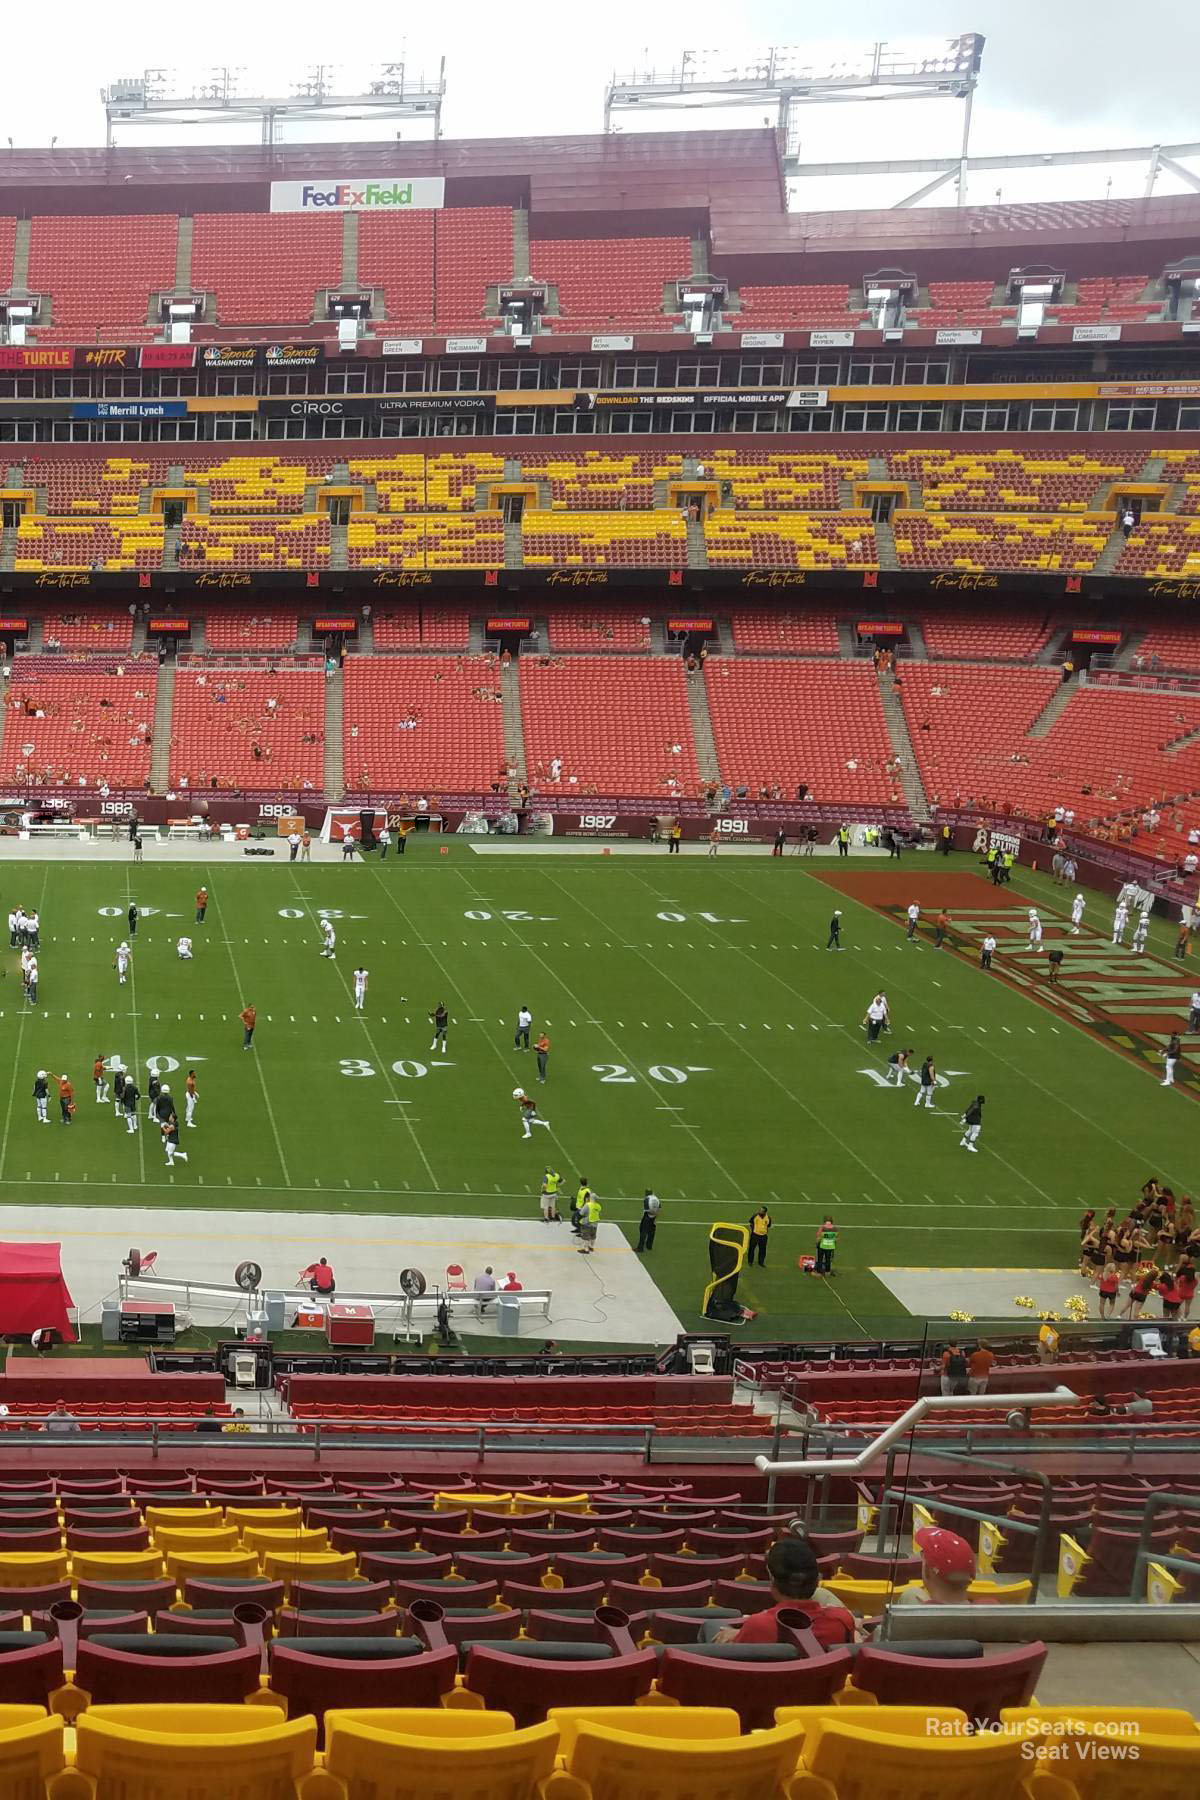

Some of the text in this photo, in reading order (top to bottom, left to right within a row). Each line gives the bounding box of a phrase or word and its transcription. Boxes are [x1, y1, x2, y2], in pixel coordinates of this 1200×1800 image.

[302, 183, 412, 207] FedExField
[220, 347, 257, 359] Sports
[283, 345, 320, 358] Sports
[205, 359, 254, 367] WASHINGTON
[267, 357, 316, 366] WASHINGTON
[110, 405, 164, 416] Merrill Lynch
[380, 401, 408, 409] ULTRA
[100, 802, 133, 815] 1982
[259, 804, 293, 817] 1983
[579, 815, 616, 828] 1987
[714, 819, 749, 833] 1991
[339, 1059, 428, 1078] 30
[591, 1064, 689, 1084] 20
